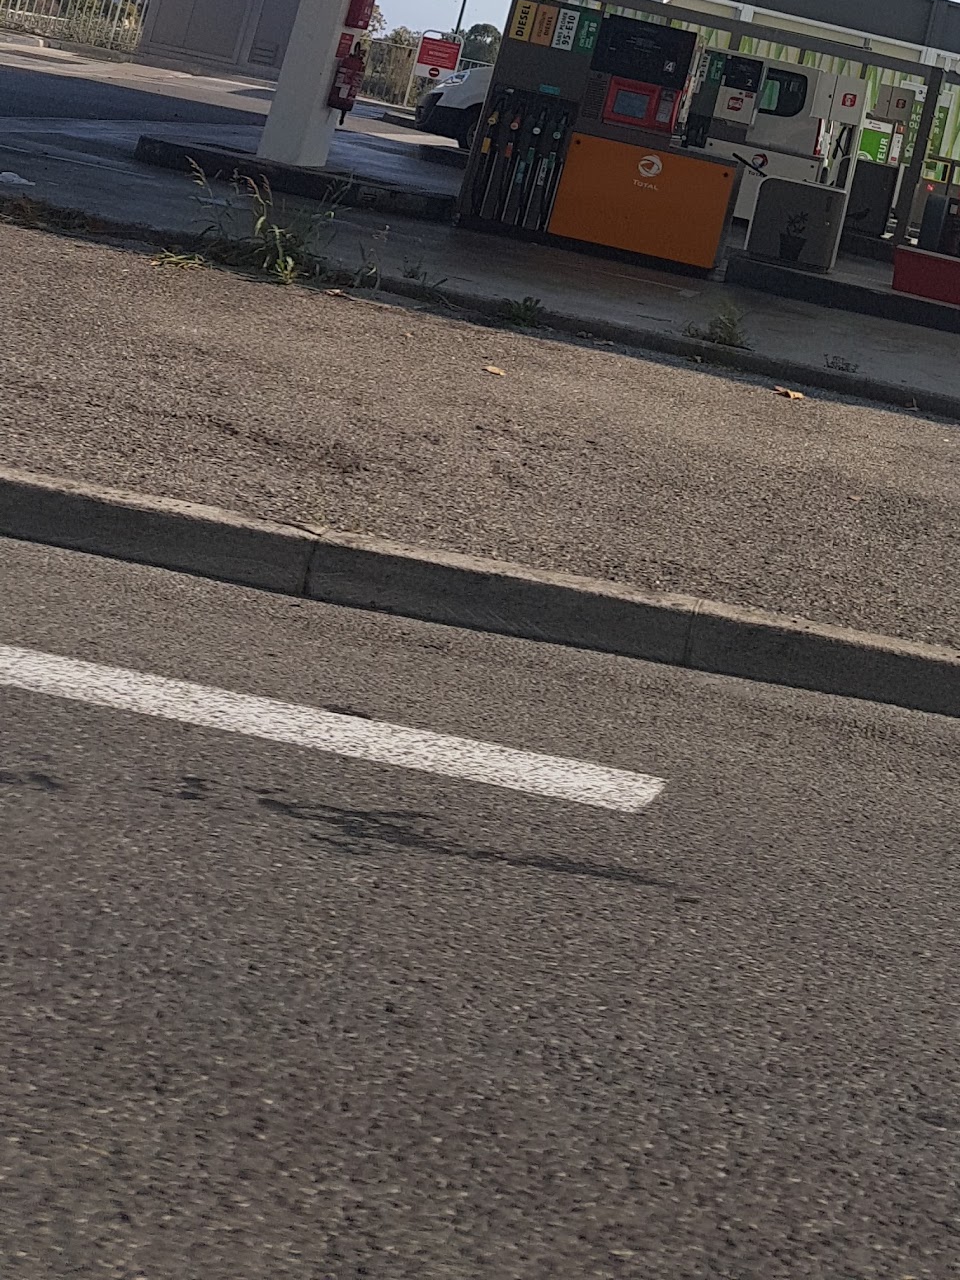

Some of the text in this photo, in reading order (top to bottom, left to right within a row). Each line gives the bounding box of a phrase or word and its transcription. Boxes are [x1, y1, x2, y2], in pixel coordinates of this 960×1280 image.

[515, 4, 532, 37] DIESEL
[562, 15, 576, 46] 95-E10
[665, 61, 674, 73] 4
[633, 179, 659, 191] TOTAL
